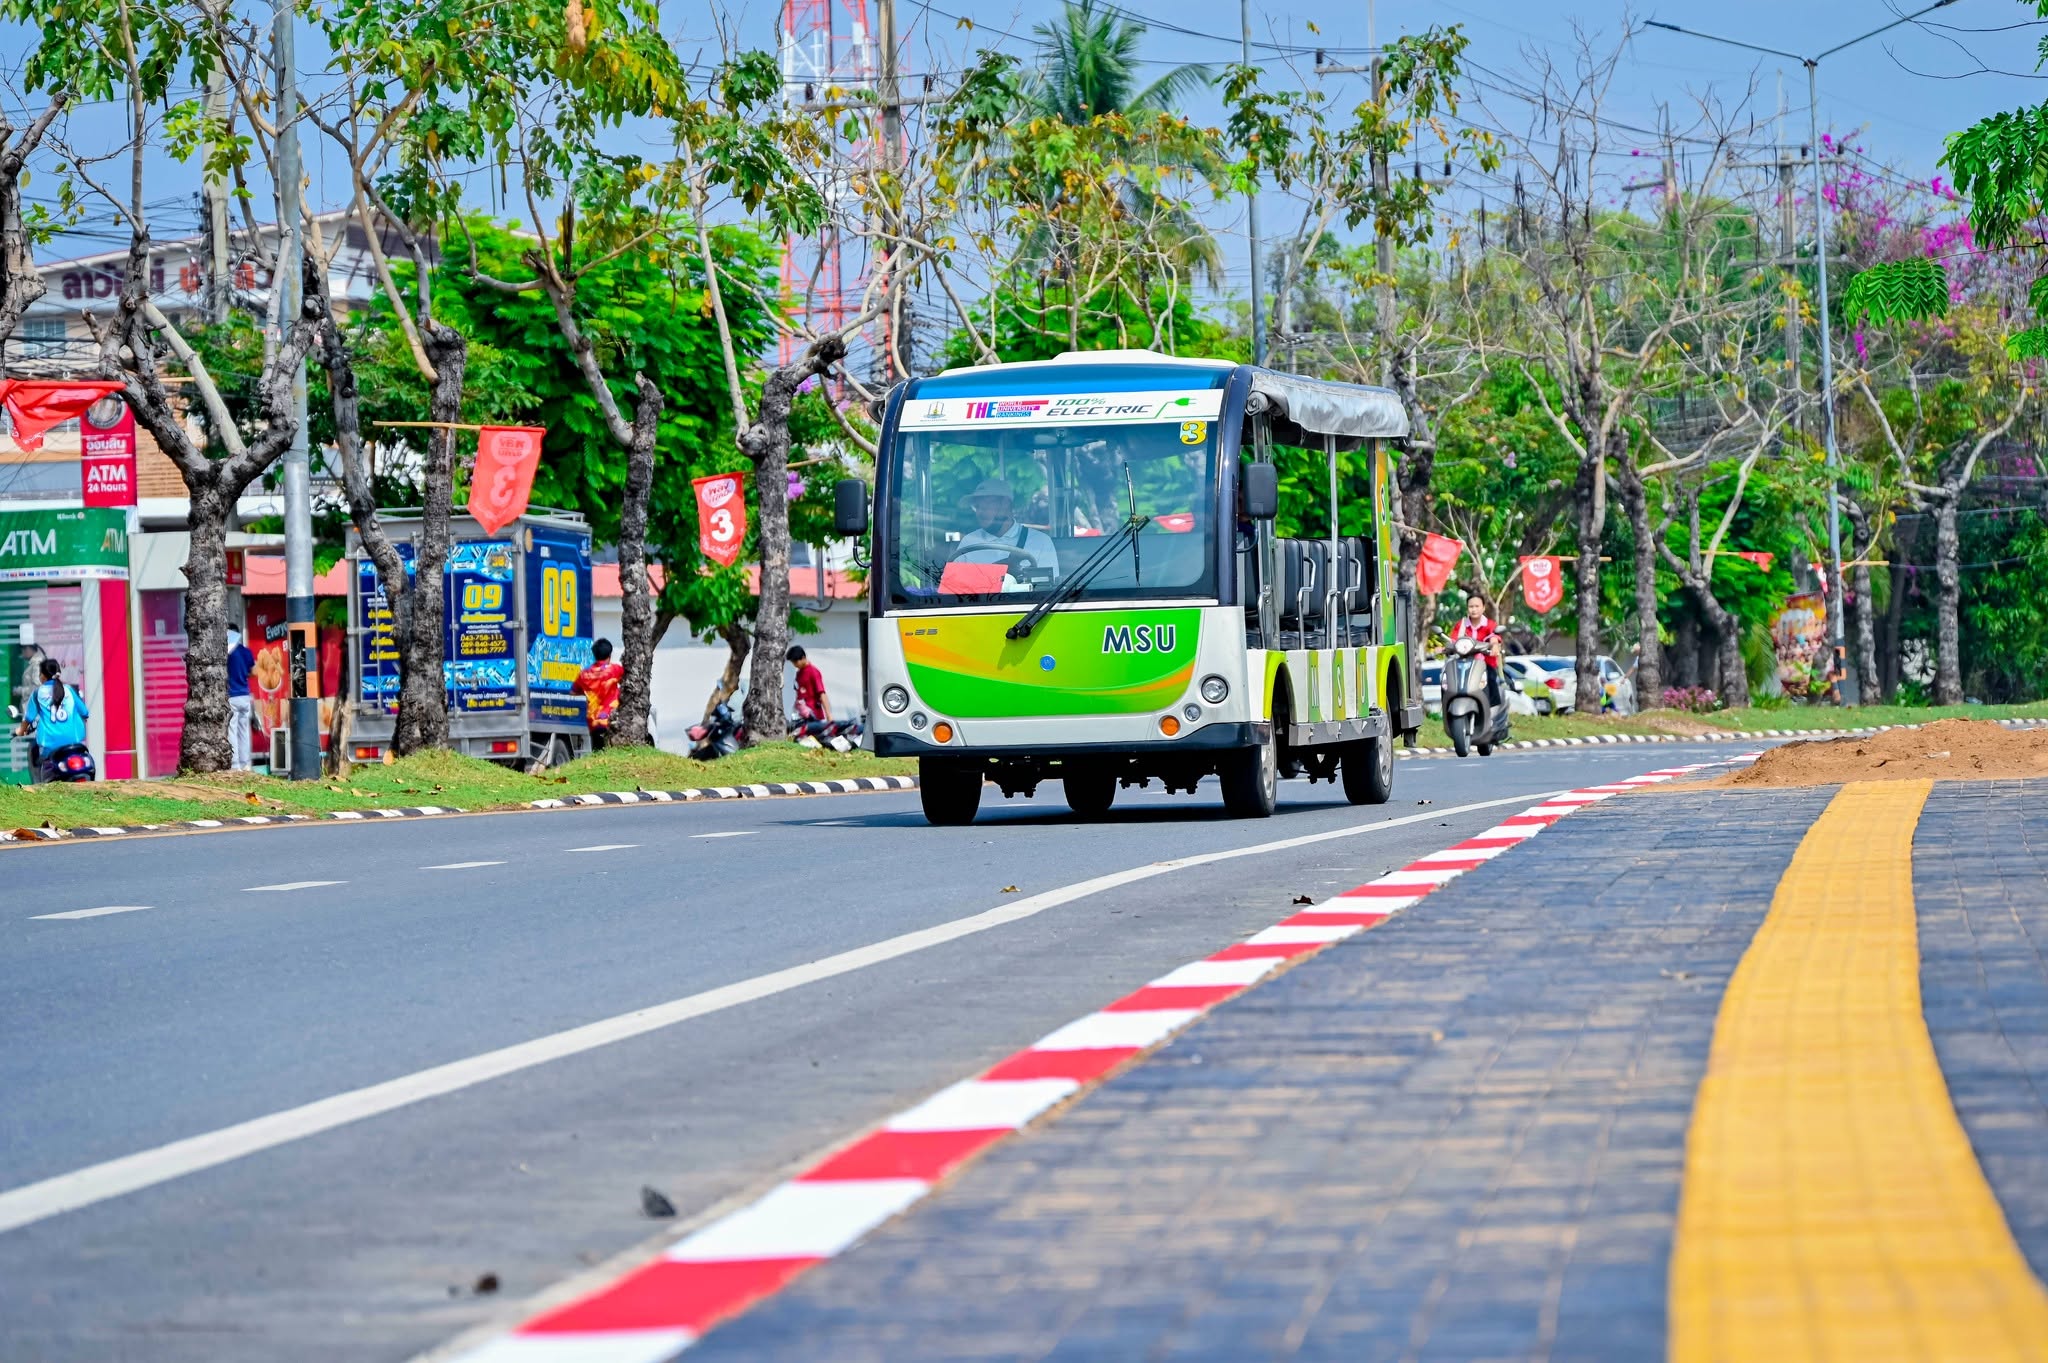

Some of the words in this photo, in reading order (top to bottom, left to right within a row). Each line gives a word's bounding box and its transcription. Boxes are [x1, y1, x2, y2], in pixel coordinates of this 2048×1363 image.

[966, 402, 998, 419] THE
[1046, 405, 1152, 416] ELECTRIC
[1055, 398, 1106, 406] 100%
[1181, 420, 1207, 445] 3
[87, 464, 127, 482] ATM
[88, 483, 99, 493] 24
[100, 481, 127, 492] hours
[710, 511, 734, 542] 3
[0, 528, 57, 556] ATM
[100, 528, 124, 553] ATM
[463, 584, 502, 609] 09
[1536, 578, 1551, 598] 3
[542, 566, 577, 638] 09
[256, 614, 267, 626] For
[1102, 624, 1176, 653] MSU
[51, 704, 68, 722] 16
